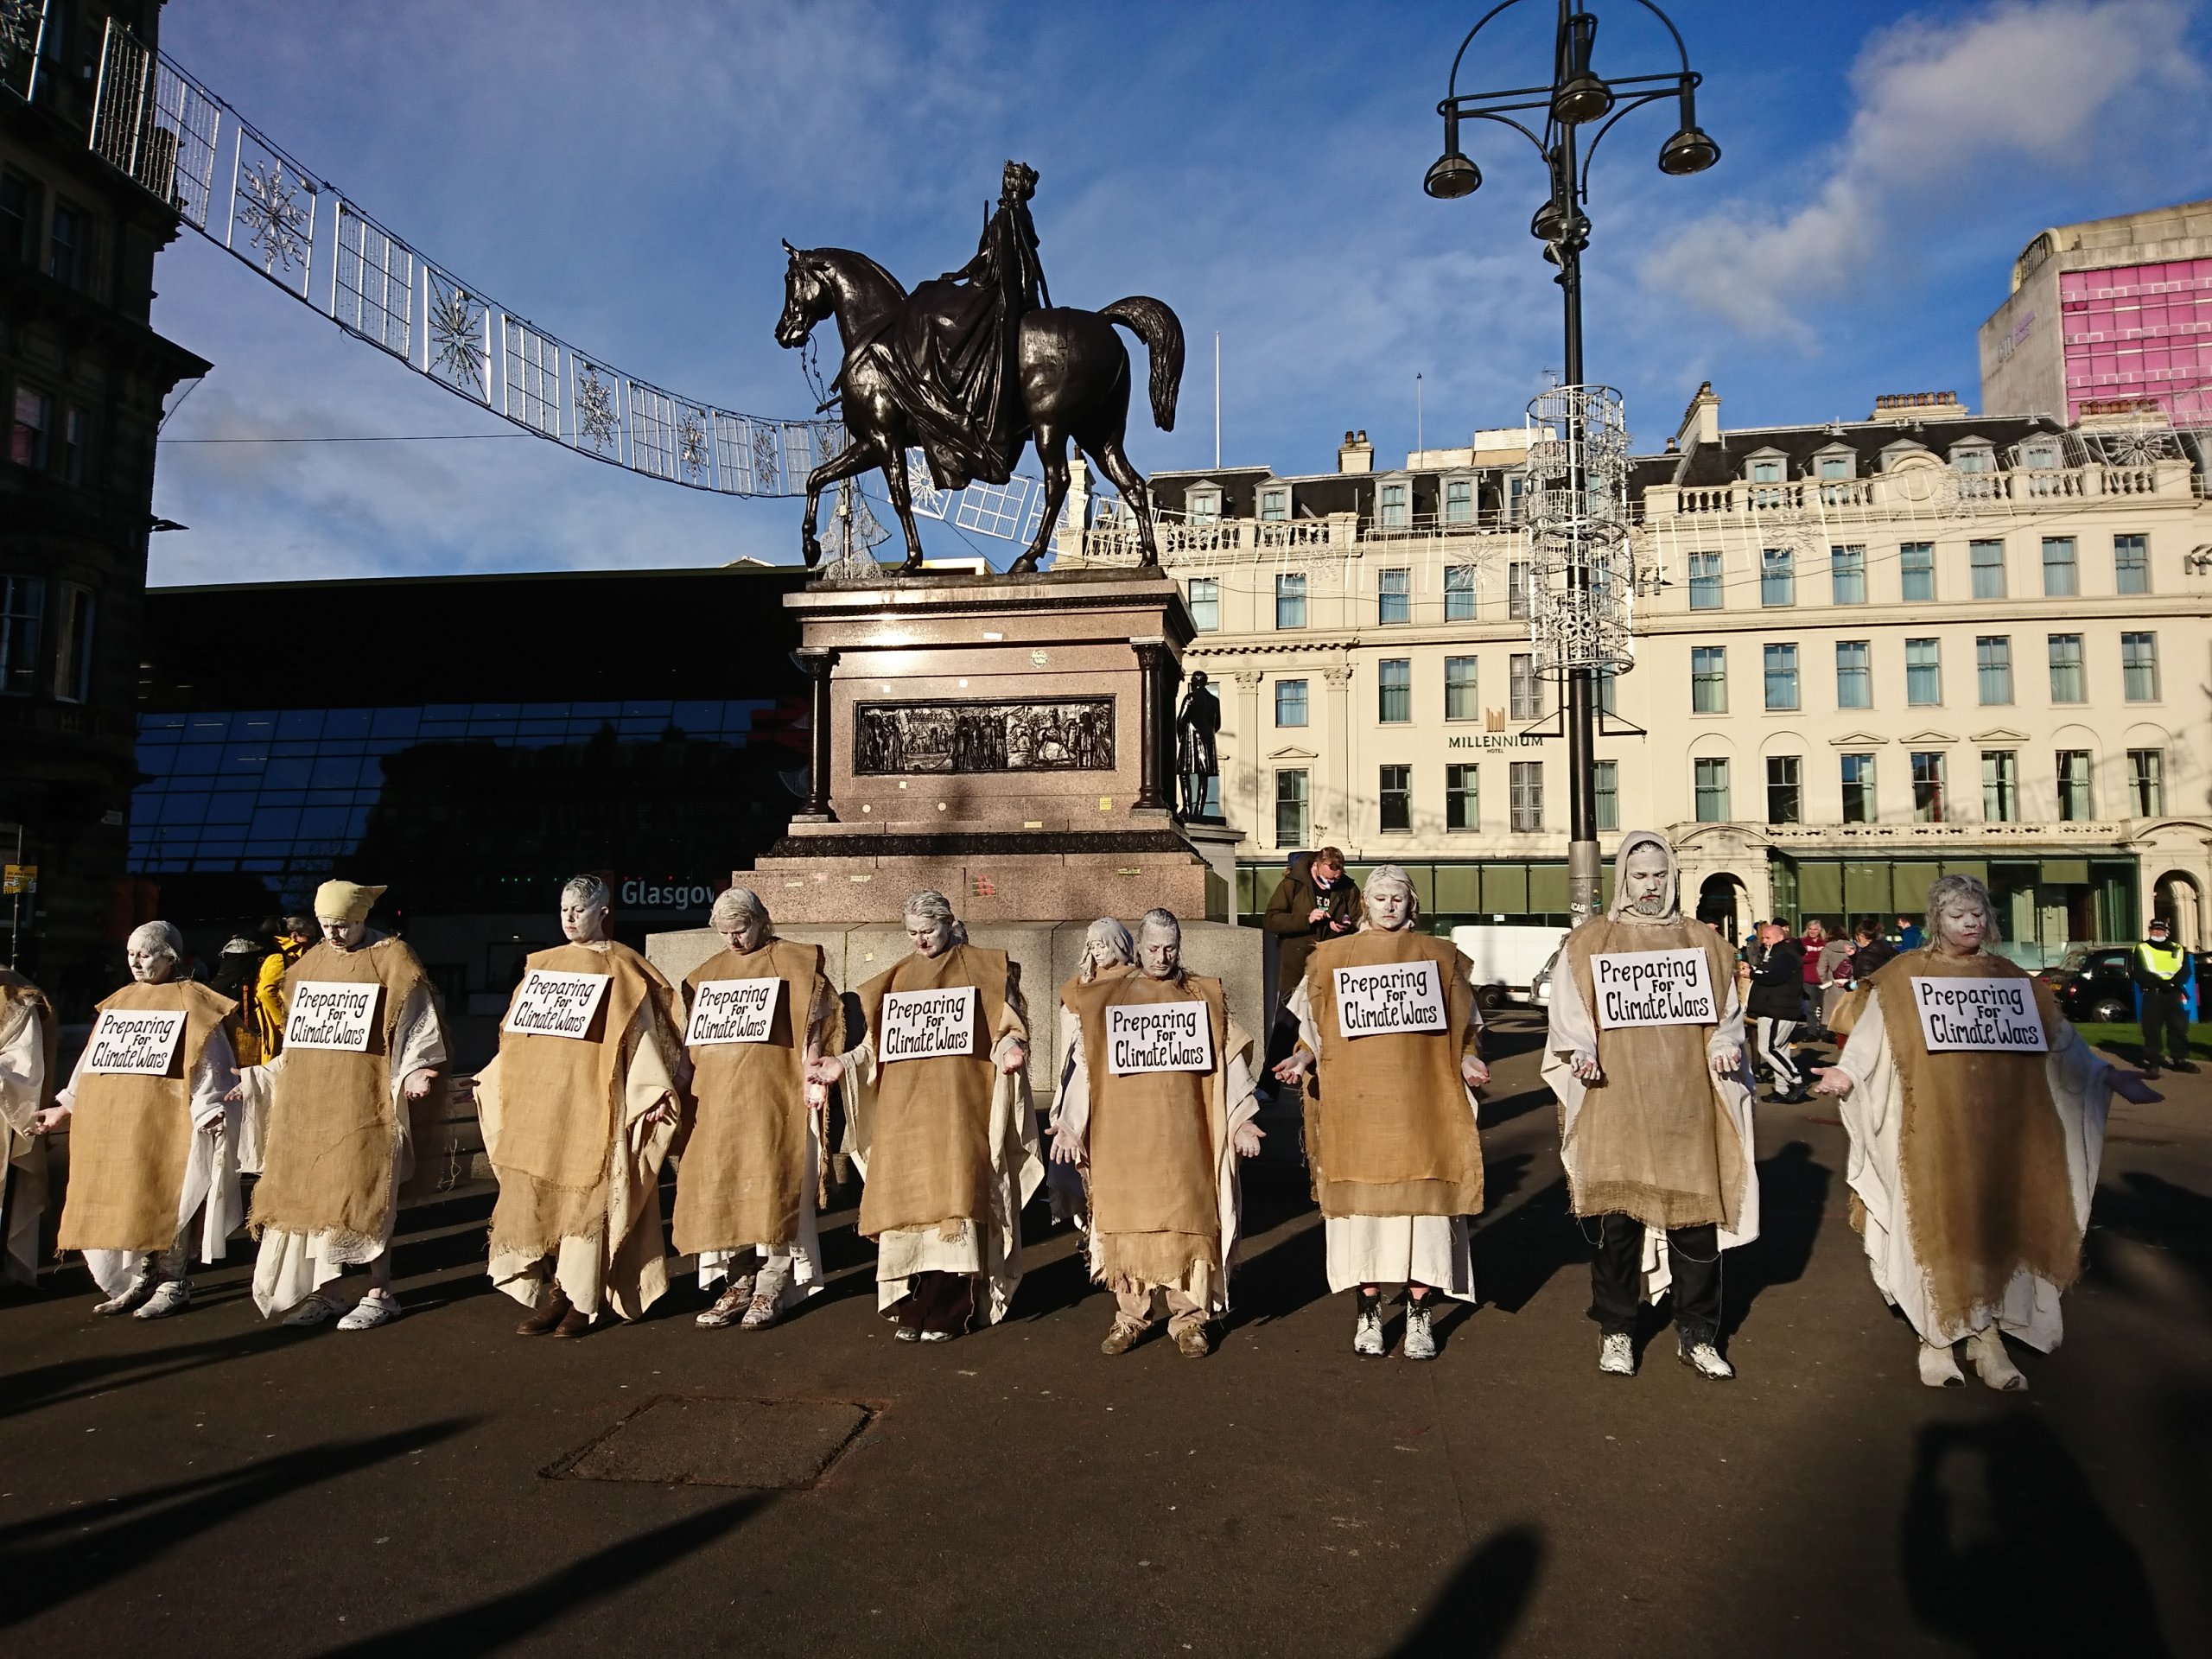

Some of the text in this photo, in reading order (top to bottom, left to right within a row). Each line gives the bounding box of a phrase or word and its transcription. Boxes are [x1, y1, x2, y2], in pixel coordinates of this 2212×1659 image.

[1448, 735, 1543, 747] MILLENNIUM
[1340, 969, 1427, 1001] Preparing
[1600, 957, 1697, 991] Preparing
[1651, 979, 1675, 994] For
[296, 987, 369, 1018] Preparing
[525, 975, 596, 1007] Preparing
[554, 996, 572, 1007] For
[698, 985, 770, 1014] Preparing
[1386, 990, 1407, 1002] For
[1921, 982, 2024, 1015] Preparing
[327, 1008, 346, 1020] For
[514, 1001, 586, 1032] Climate Wars
[731, 1004, 748, 1016] For
[887, 995, 966, 1027] Preparing
[1344, 1001, 1438, 1029] Climate Wars
[1605, 991, 1709, 1021] Climate Wars
[1977, 1005, 2001, 1019] For
[100, 1014, 175, 1044] Preparing
[290, 1015, 365, 1045] Climate Wars
[693, 1014, 766, 1039] Climate Wars
[925, 1015, 944, 1028] For
[1113, 1009, 1196, 1040] Preparing
[1930, 1014, 2039, 1045] Climate Wars
[132, 1034, 151, 1046] For
[887, 1026, 968, 1054] Climate Wars
[1156, 1030, 1176, 1042] For
[92, 1041, 168, 1068] Climate Wars
[1116, 1040, 1204, 1068] Climate Wars
